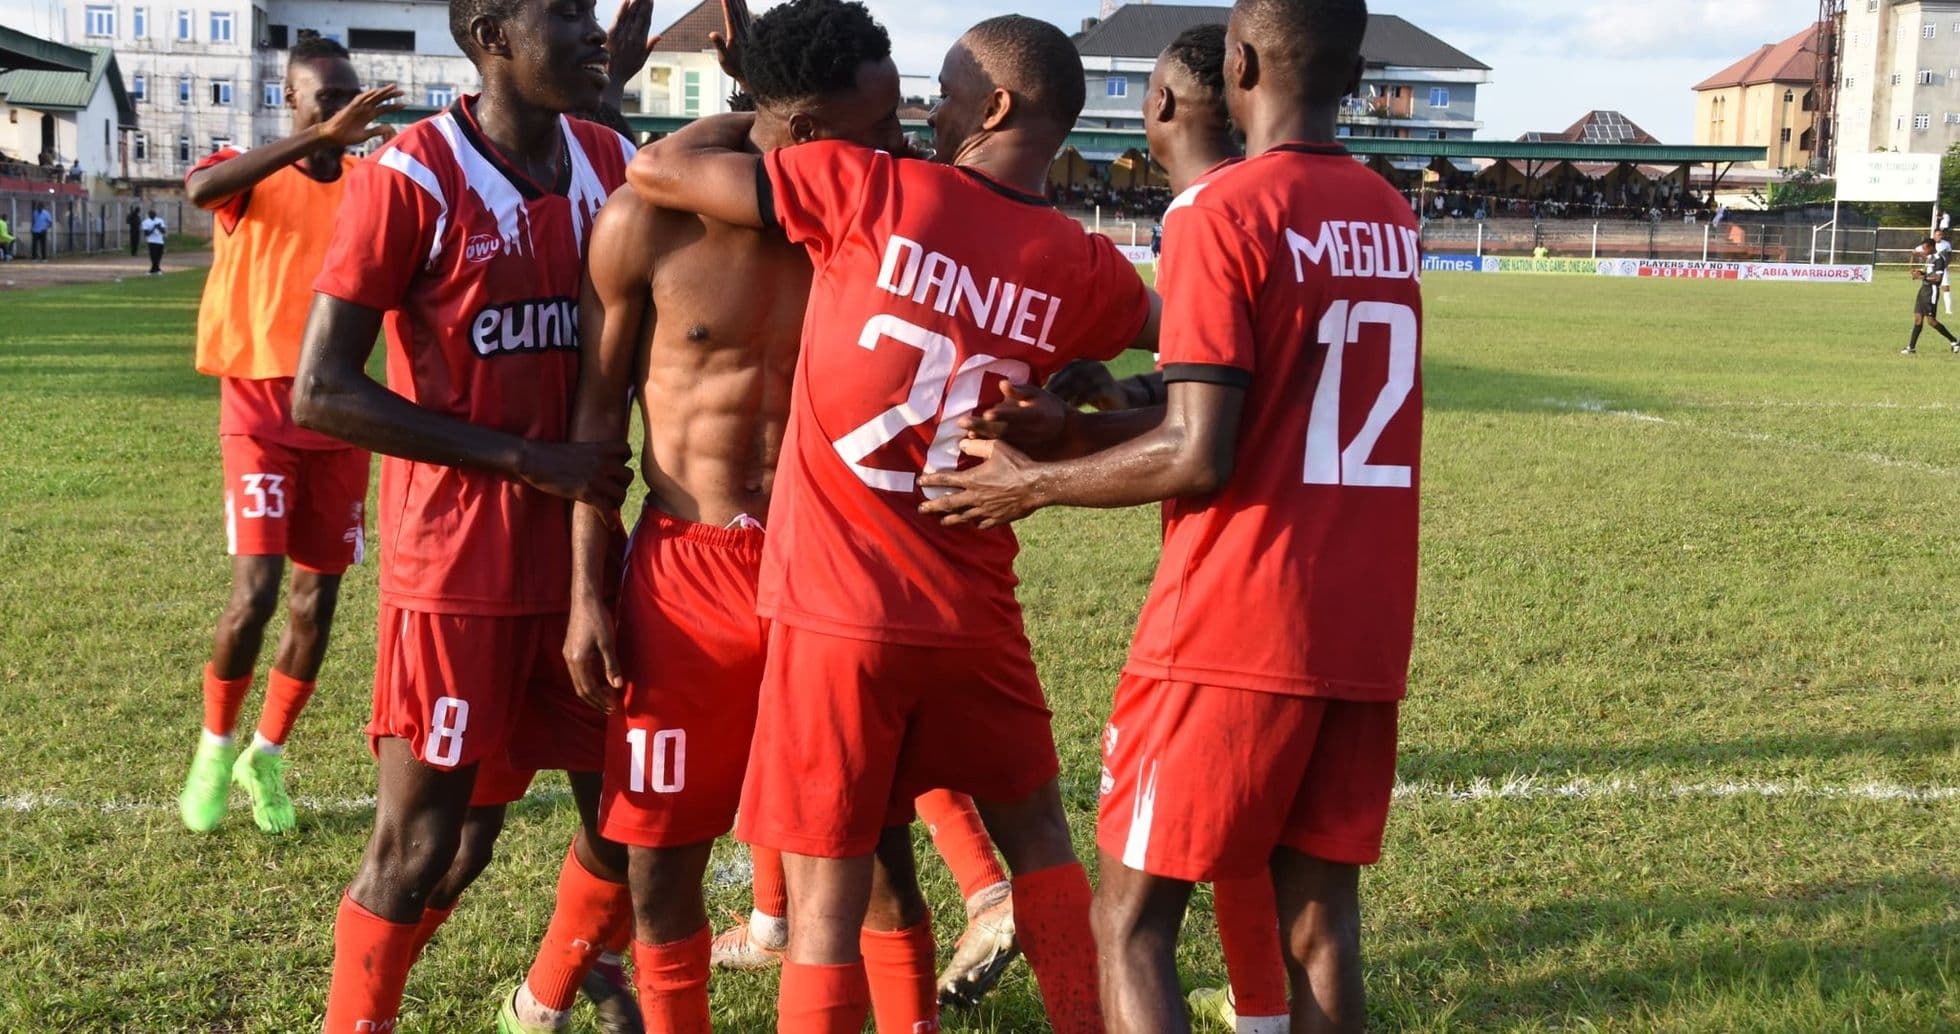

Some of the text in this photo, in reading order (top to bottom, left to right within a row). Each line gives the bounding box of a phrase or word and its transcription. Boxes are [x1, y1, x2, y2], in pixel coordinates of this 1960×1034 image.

[876, 234, 1062, 352] DANIEL
[1639, 260, 1740, 271] PLAYERS SAY NO TO
[1762, 267, 1850, 278] ABIA WARRIORS
[1303, 299, 1417, 488] 12
[241, 473, 286, 518] 33
[425, 696, 469, 767] 8
[626, 728, 687, 793] 10
